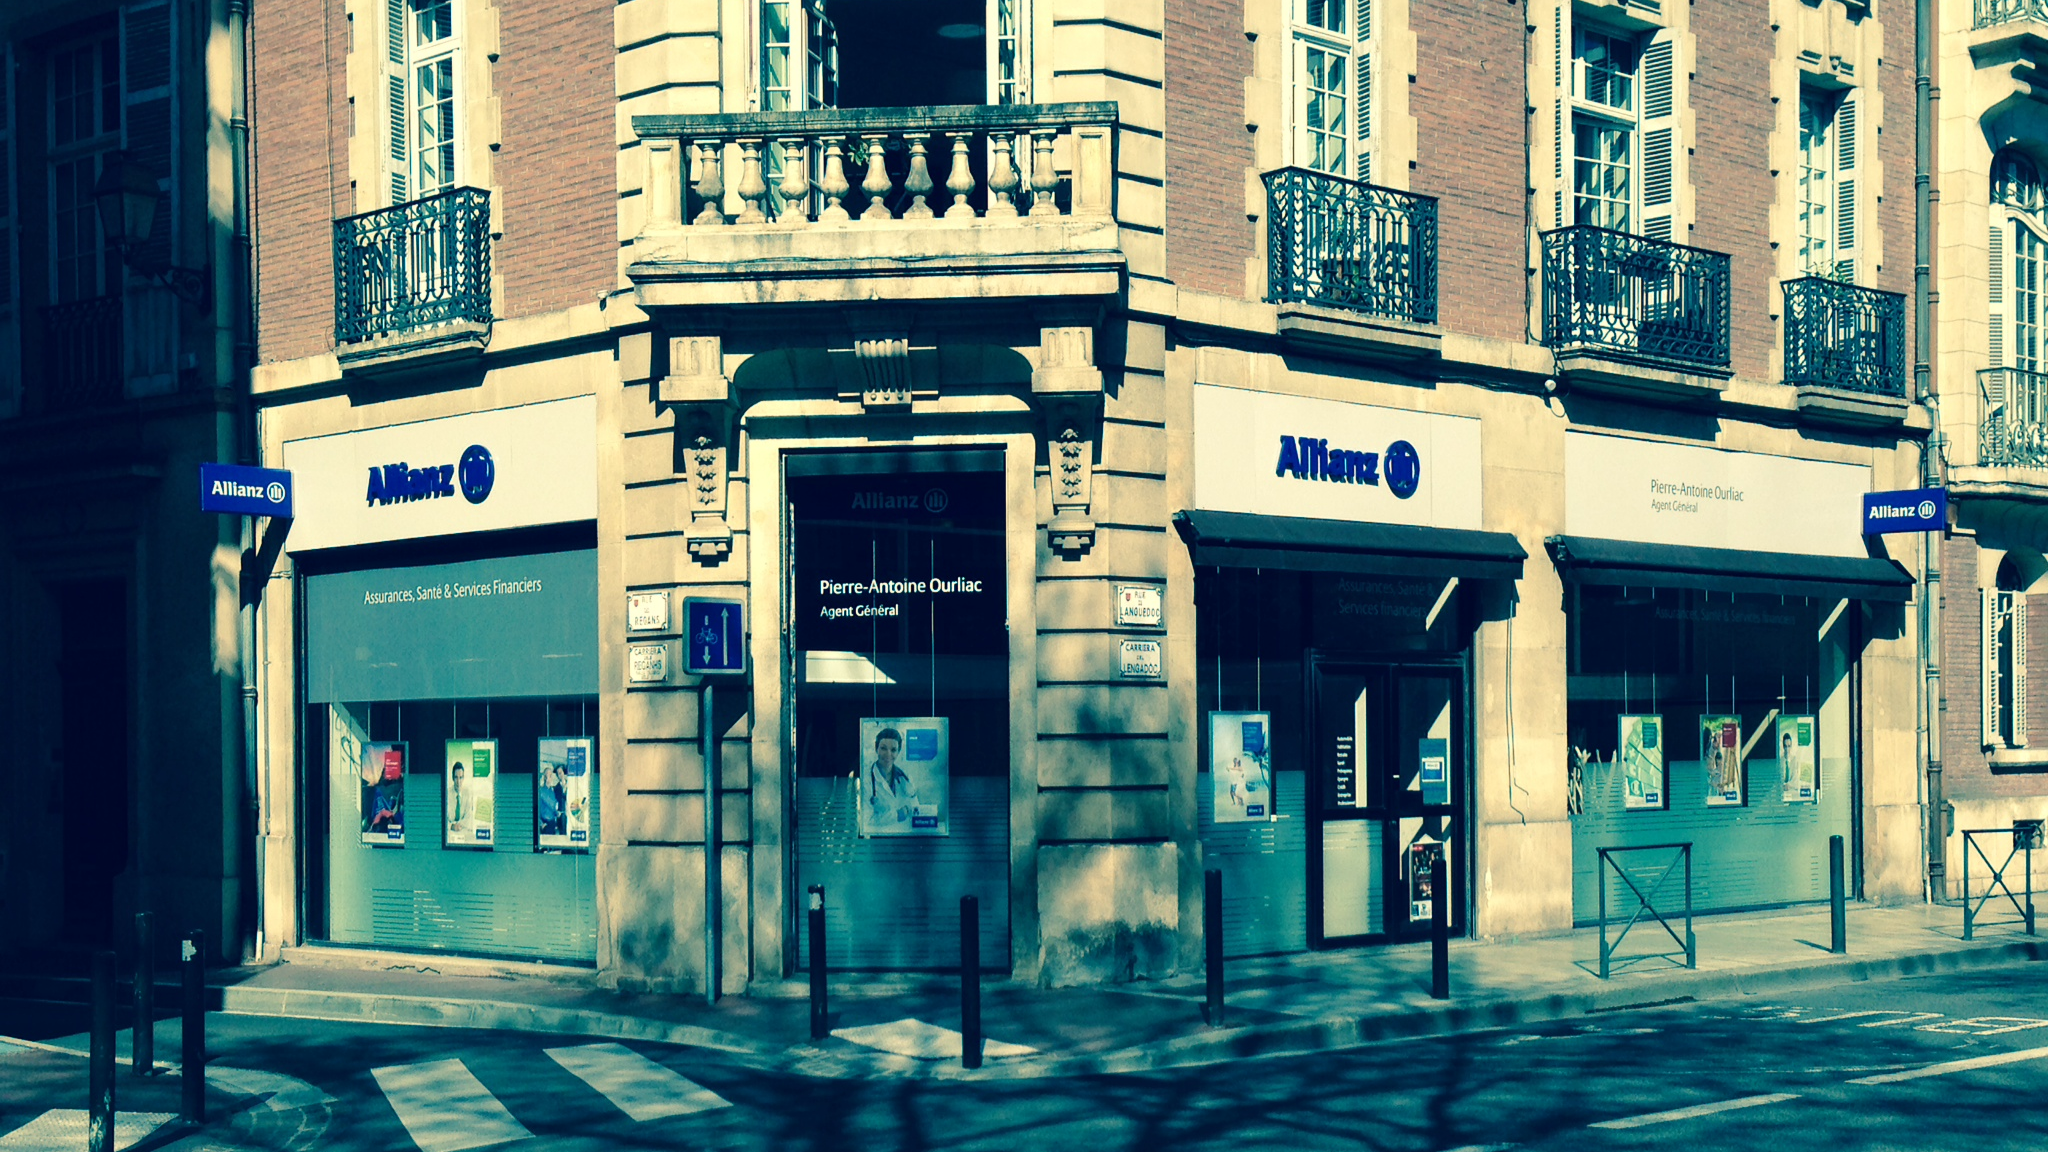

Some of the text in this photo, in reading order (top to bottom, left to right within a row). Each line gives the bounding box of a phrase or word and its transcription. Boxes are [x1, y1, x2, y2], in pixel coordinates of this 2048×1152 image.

[1276, 435, 1379, 486] Allianz
[211, 480, 264, 498] Allianz
[366, 461, 455, 507] Allianz
[1651, 479, 1744, 501] Pierre-Antoine Ourliac
[852, 492, 919, 509] Allianz
[1651, 499, 1698, 512] Agent Général
[1869, 505, 1915, 519] Allianz
[364, 576, 542, 605] Assurances, Santé & Services Financiers
[820, 577, 983, 594] Pierre-Antoine Ourliac
[1338, 577, 1395, 596] Assurances,
[1398, 581, 1425, 596] Santé
[820, 604, 899, 619] Agent Général
[1338, 599, 1379, 615] Services
[1123, 663, 1158, 674] LENGADOC
